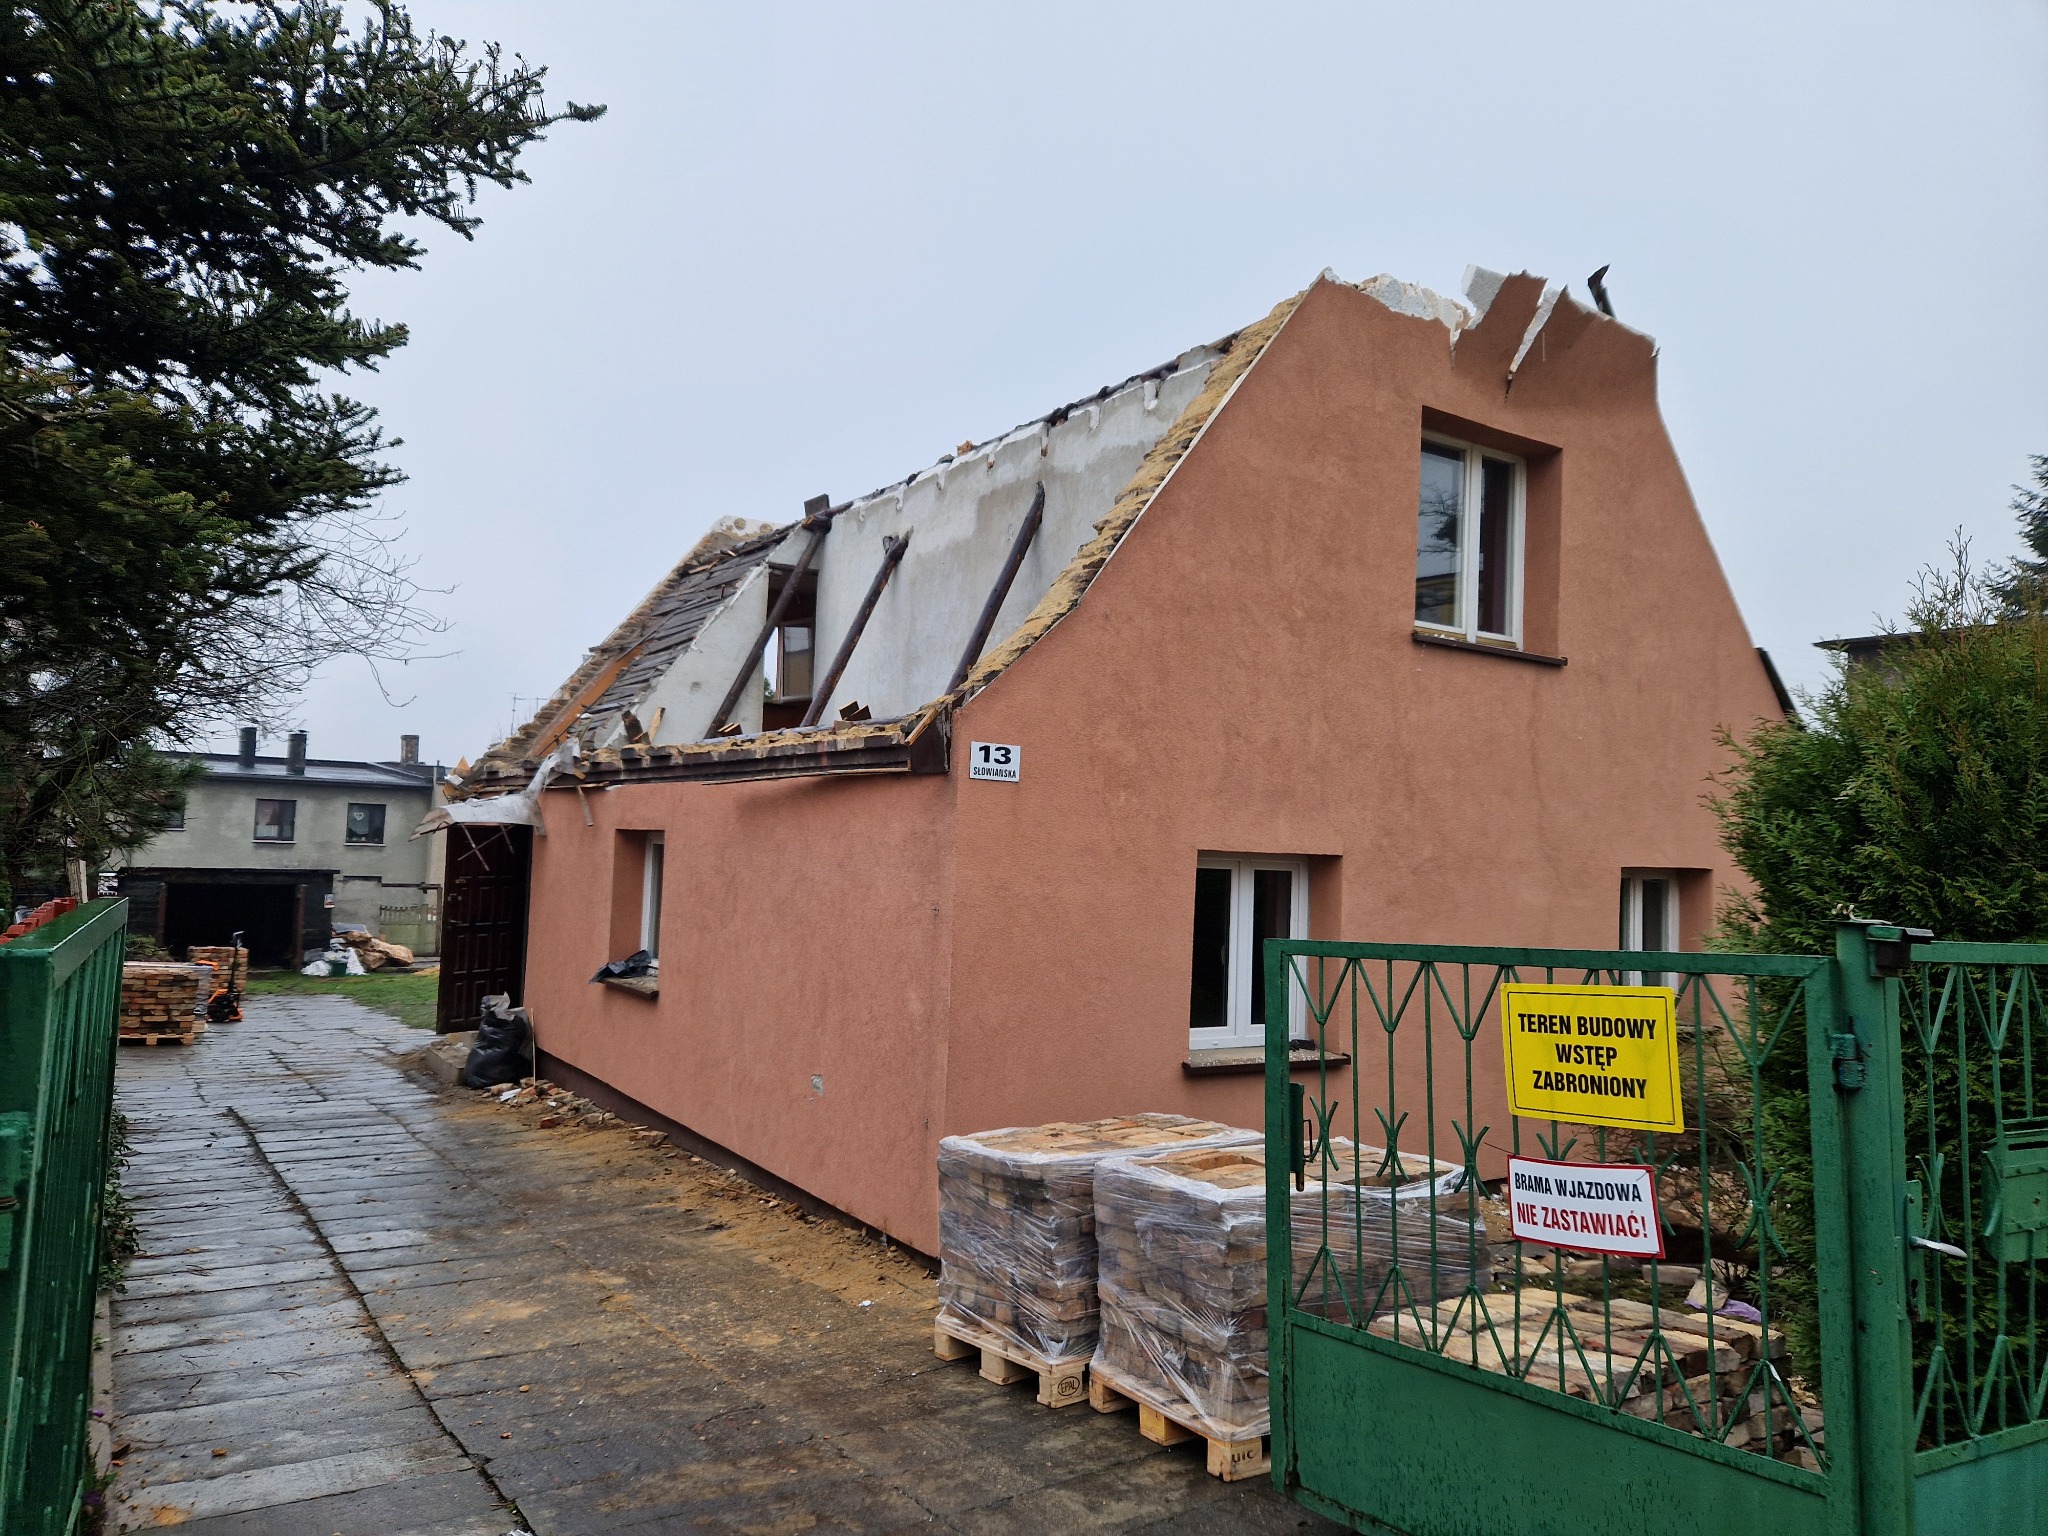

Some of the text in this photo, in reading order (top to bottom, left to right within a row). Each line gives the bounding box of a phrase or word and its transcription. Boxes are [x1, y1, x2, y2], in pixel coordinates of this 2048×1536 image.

[978, 744, 1012, 765] 13
[973, 766, 1017, 779] SŁOWIAŃSKA
[1517, 1013, 1657, 1040] TEREN BUDOWY
[1555, 1043, 1618, 1071] WSTĘP
[1532, 1070, 1647, 1100] ZABRONIONY
[1514, 1172, 1643, 1203] BRAMA WJAZDOWA
[1516, 1201, 1648, 1239] NIE ZASTAWIAĆ!
[1060, 1379, 1077, 1394] EPAL
